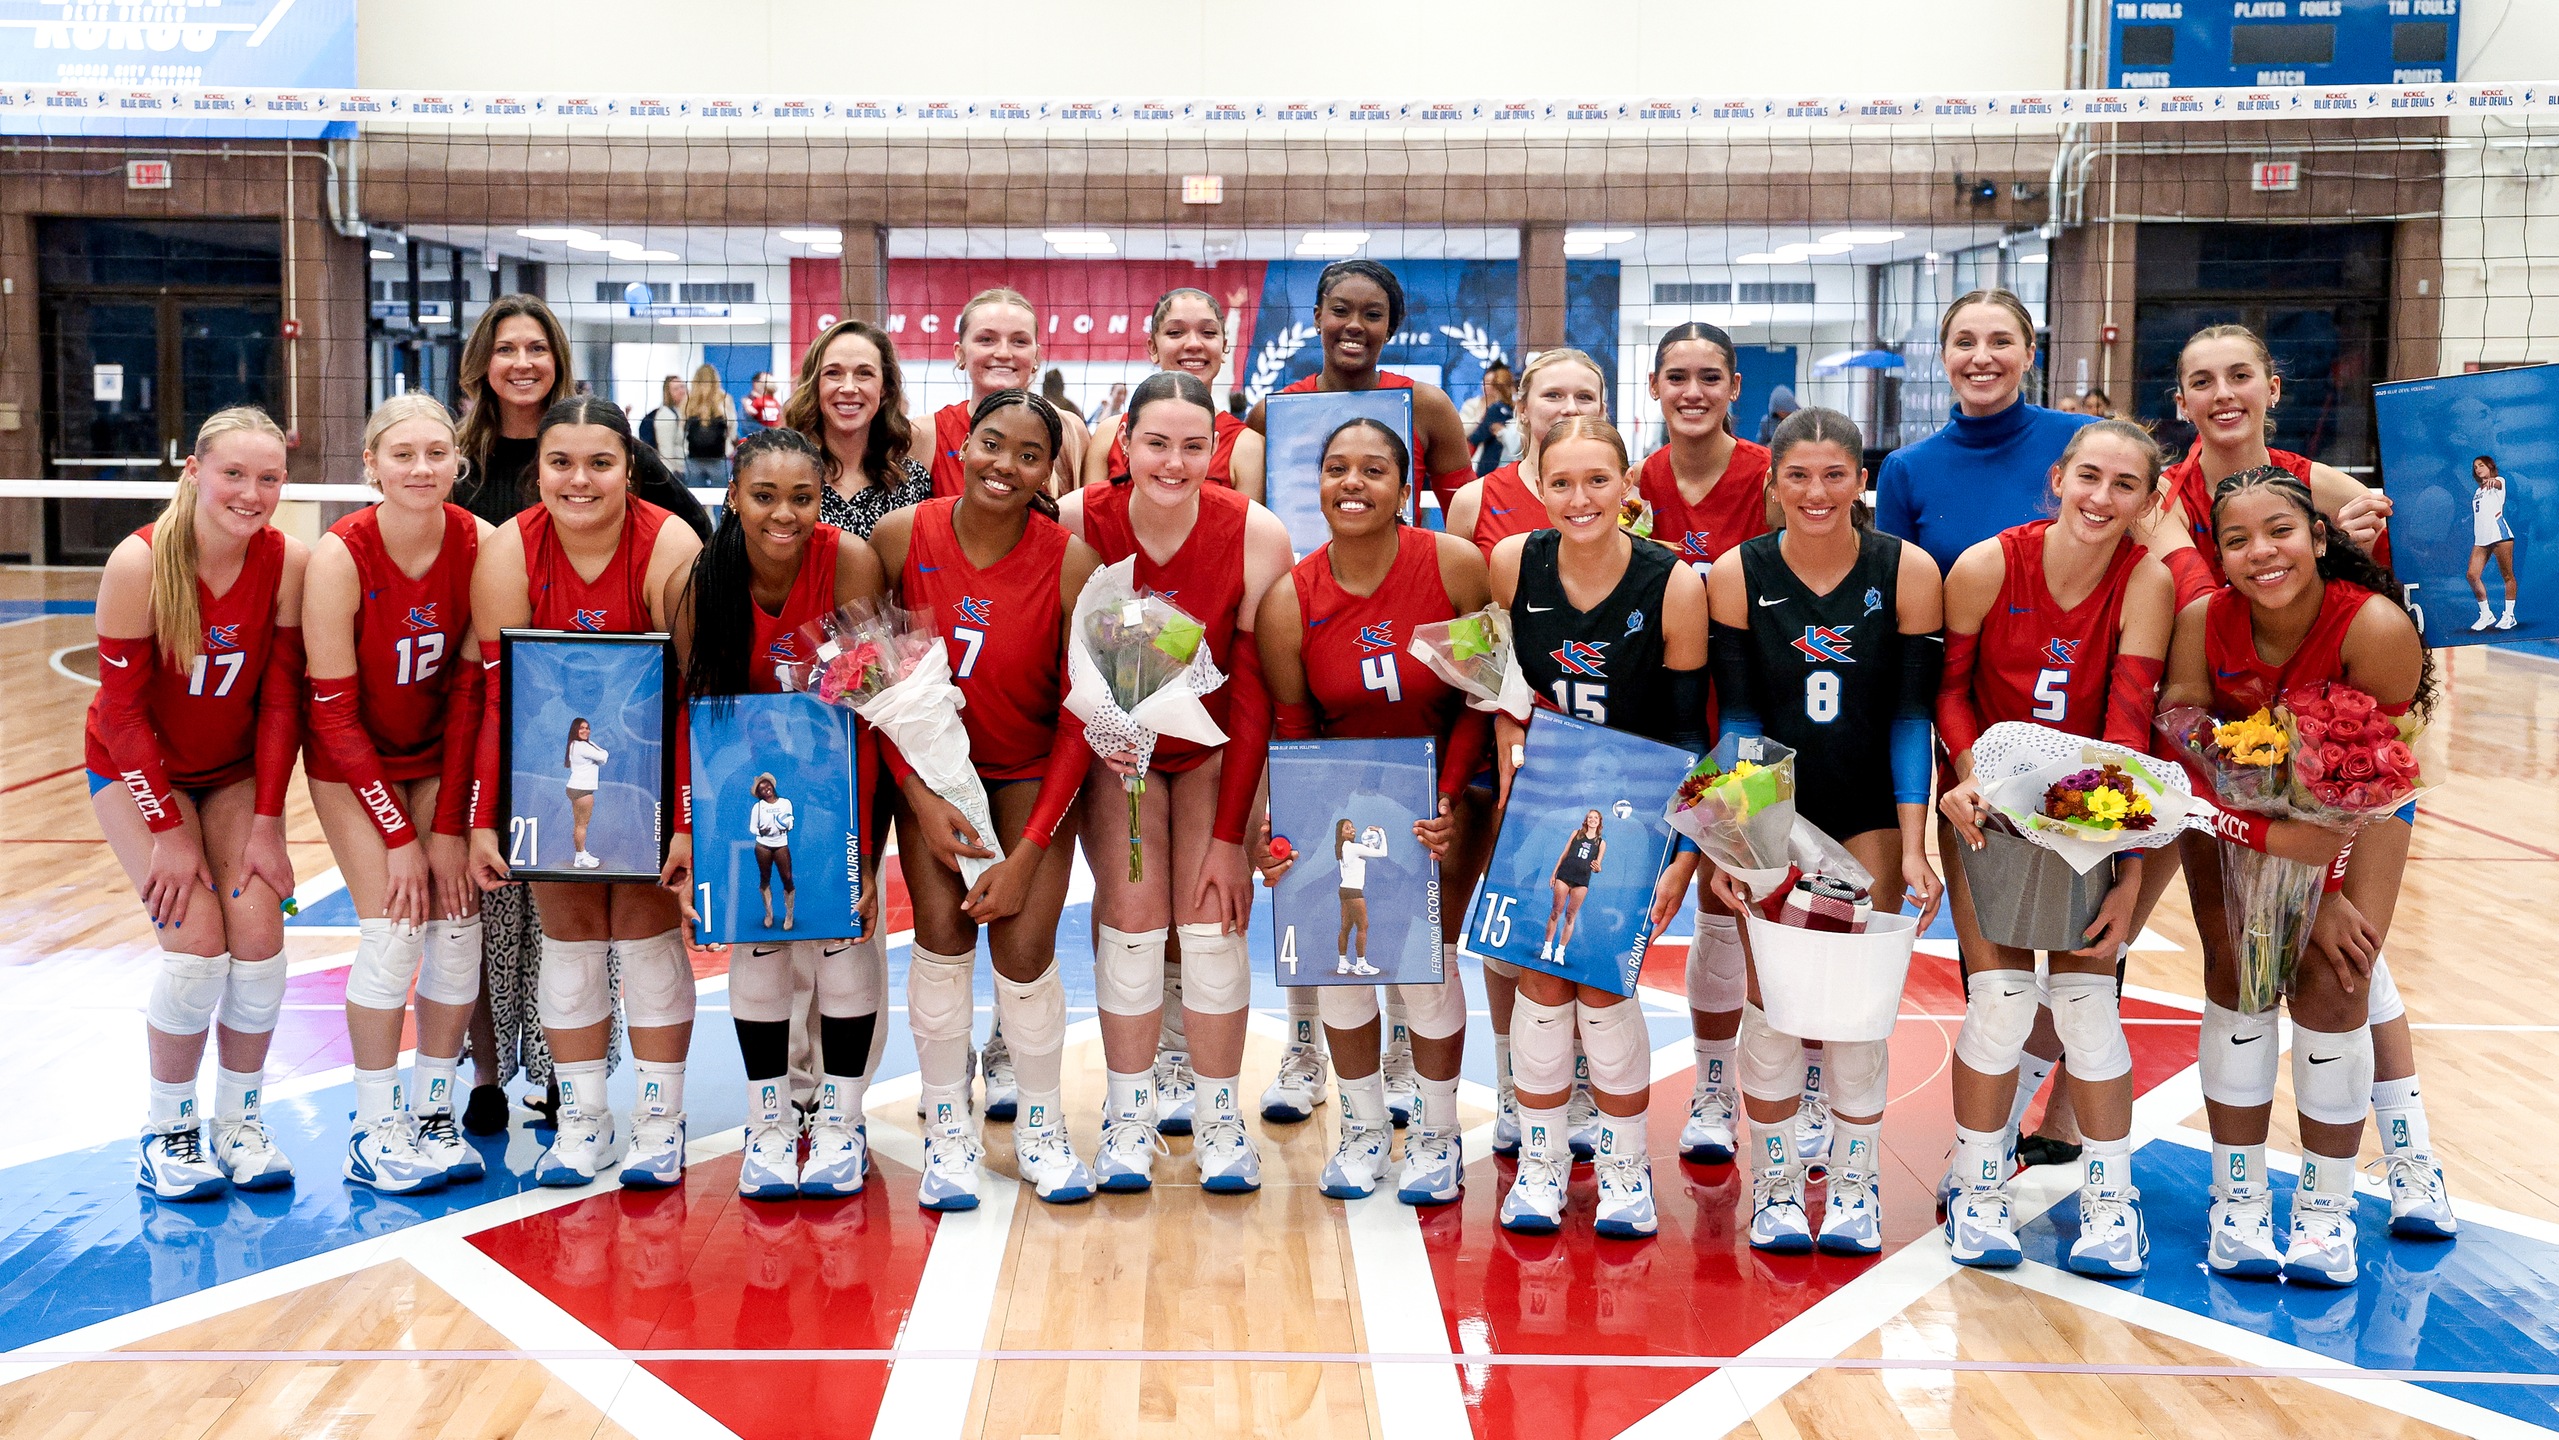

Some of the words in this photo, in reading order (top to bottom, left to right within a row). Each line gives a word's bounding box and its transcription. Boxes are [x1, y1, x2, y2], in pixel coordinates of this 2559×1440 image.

[2117, 4, 2137, 19] TM
[2141, 4, 2182, 19] FOULS
[2234, 2, 2286, 18] PLAYER
[2299, 1, 2342, 17] FOULS
[2389, 0, 2410, 16] TM
[2413, 0, 2456, 15] FOULS
[2122, 72, 2170, 88] POINTS
[2257, 71, 2305, 86] MATCH
[2393, 69, 2442, 83] POINTS
[1936, 106, 1952, 115] BLUE
[1954, 106, 1977, 115] DEVILS
[2011, 105, 2027, 114] BLUE
[2029, 105, 2052, 114] DEVILS
[2086, 104, 2102, 113] BLUE
[2104, 104, 2127, 113] DEVILS
[2162, 103, 2178, 112] BLUE
[2181, 103, 2203, 112] DEVILS
[2238, 101, 2254, 110] BLUE
[2257, 101, 2280, 110] DEVILS
[2314, 100, 2330, 109] BLUE
[2333, 100, 2356, 109] DEVILS
[2392, 98, 2409, 107] BLUE
[2411, 98, 2434, 107] DEVILS
[2469, 97, 2486, 106] BLUE
[2488, 97, 2512, 106] DEVILS
[396, 632, 445, 684] 12
[953, 625, 986, 678] 7
[188, 651, 246, 697] 17
[1360, 652, 1402, 702] 4
[1551, 679, 1607, 724] 15
[1805, 670, 1841, 724] 8
[2032, 668, 2070, 722] 5
[360, 780, 406, 834] KCKCC
[509, 815, 538, 866] 21
[2208, 809, 2250, 844] CKCC
[846, 832, 860, 883] MURRAY
[1577, 847, 1590, 859] 15
[698, 882, 712, 933] 1
[1427, 880, 1440, 924] OCORO
[1479, 892, 1518, 948] 15
[1280, 924, 1298, 975] 4
[1431, 926, 1442, 974] FERNANDA
[1628, 933, 1647, 971] RANN
[1624, 969, 1635, 990] AVA
